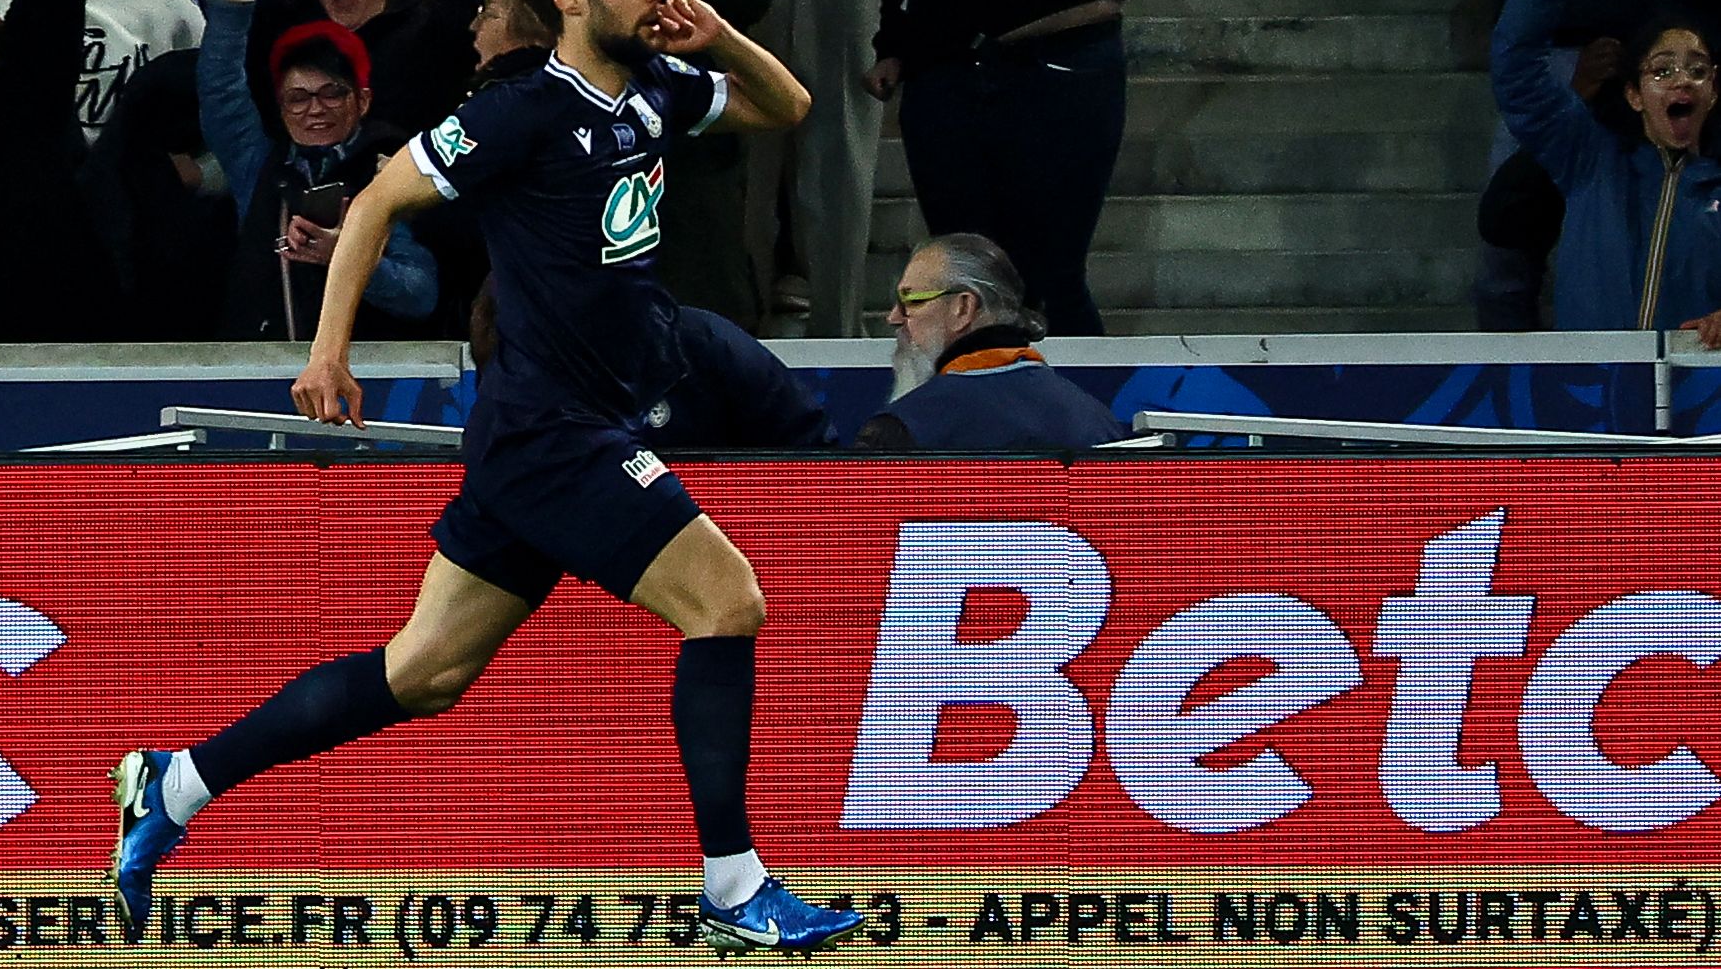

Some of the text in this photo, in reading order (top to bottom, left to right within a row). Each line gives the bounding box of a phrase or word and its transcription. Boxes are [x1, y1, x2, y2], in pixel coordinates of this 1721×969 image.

[839, 506, 1721, 834] Betc
[399, 892, 496, 961] (09
[522, 893, 598, 945] 74
[621, 893, 700, 944] 75
[969, 893, 1192, 943] APPEL
[1216, 892, 1358, 943] NON
[1385, 880, 1714, 954] SURTAXÉ)
